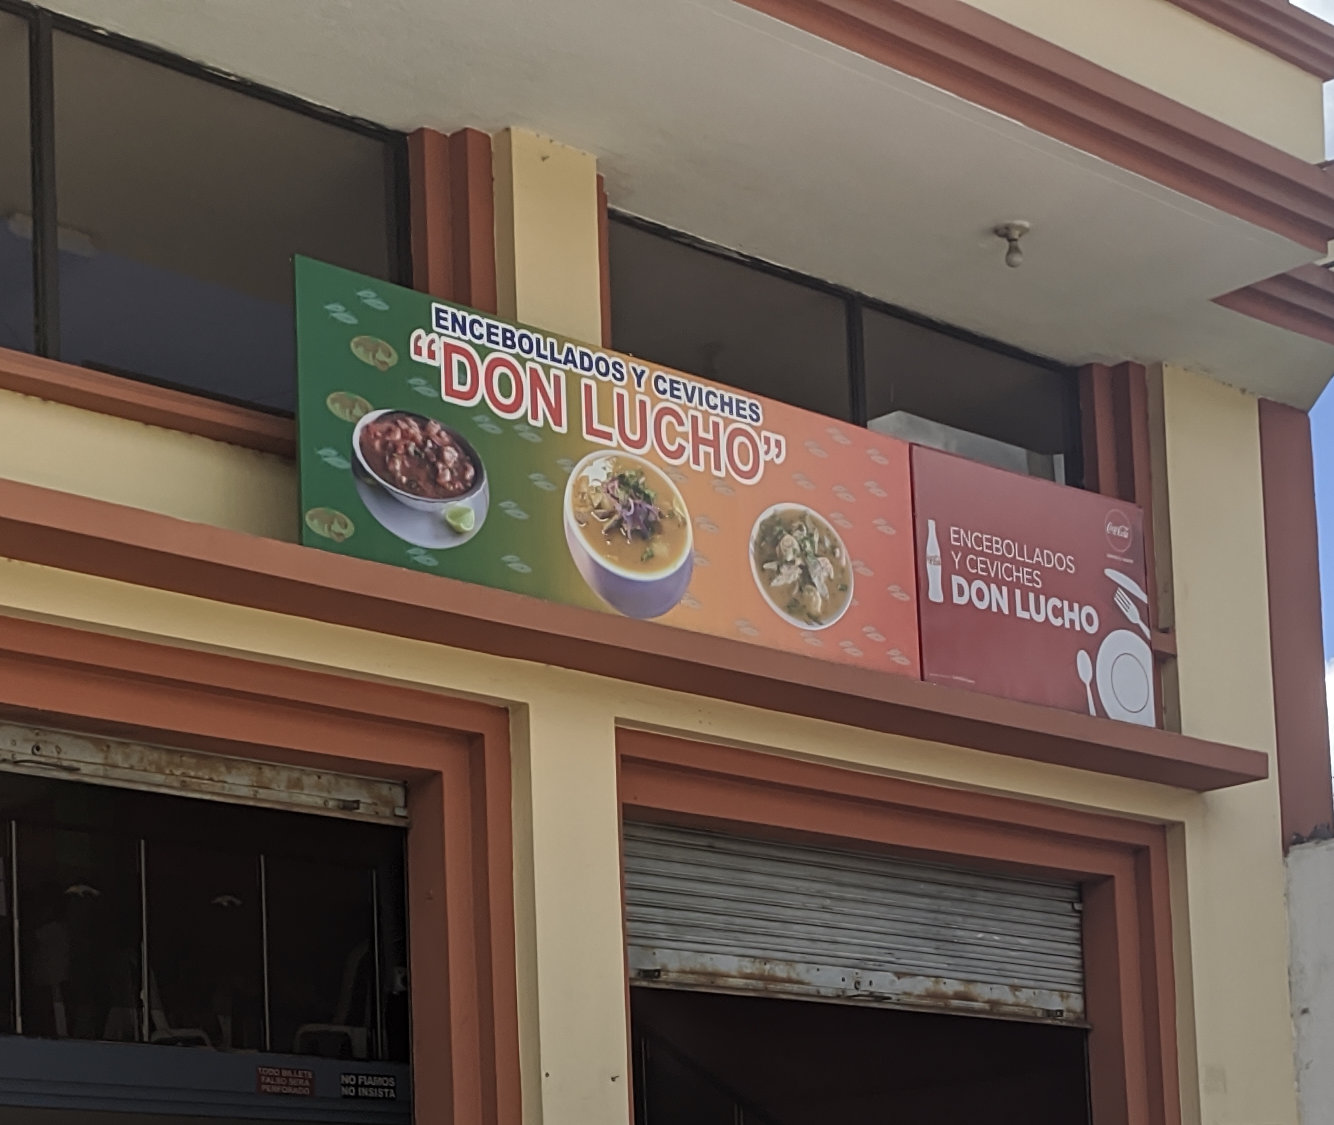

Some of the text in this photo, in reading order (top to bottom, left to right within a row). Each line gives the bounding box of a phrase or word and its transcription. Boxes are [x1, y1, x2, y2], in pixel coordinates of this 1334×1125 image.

[433, 304, 762, 423] ENCEBOLLADOS Y CEVICHES
[950, 526, 1076, 589] ENCEBOLLADOS Y CEVICHES
[951, 574, 1099, 634] DON LUCHO
[258, 1067, 313, 1079] TODO BILLETE
[261, 1077, 287, 1086] FALSO
[341, 1074, 395, 1087] NO FIAMOS
[261, 1085, 310, 1095] PERFORADO
[341, 1086, 396, 1098] NO INSISTA
